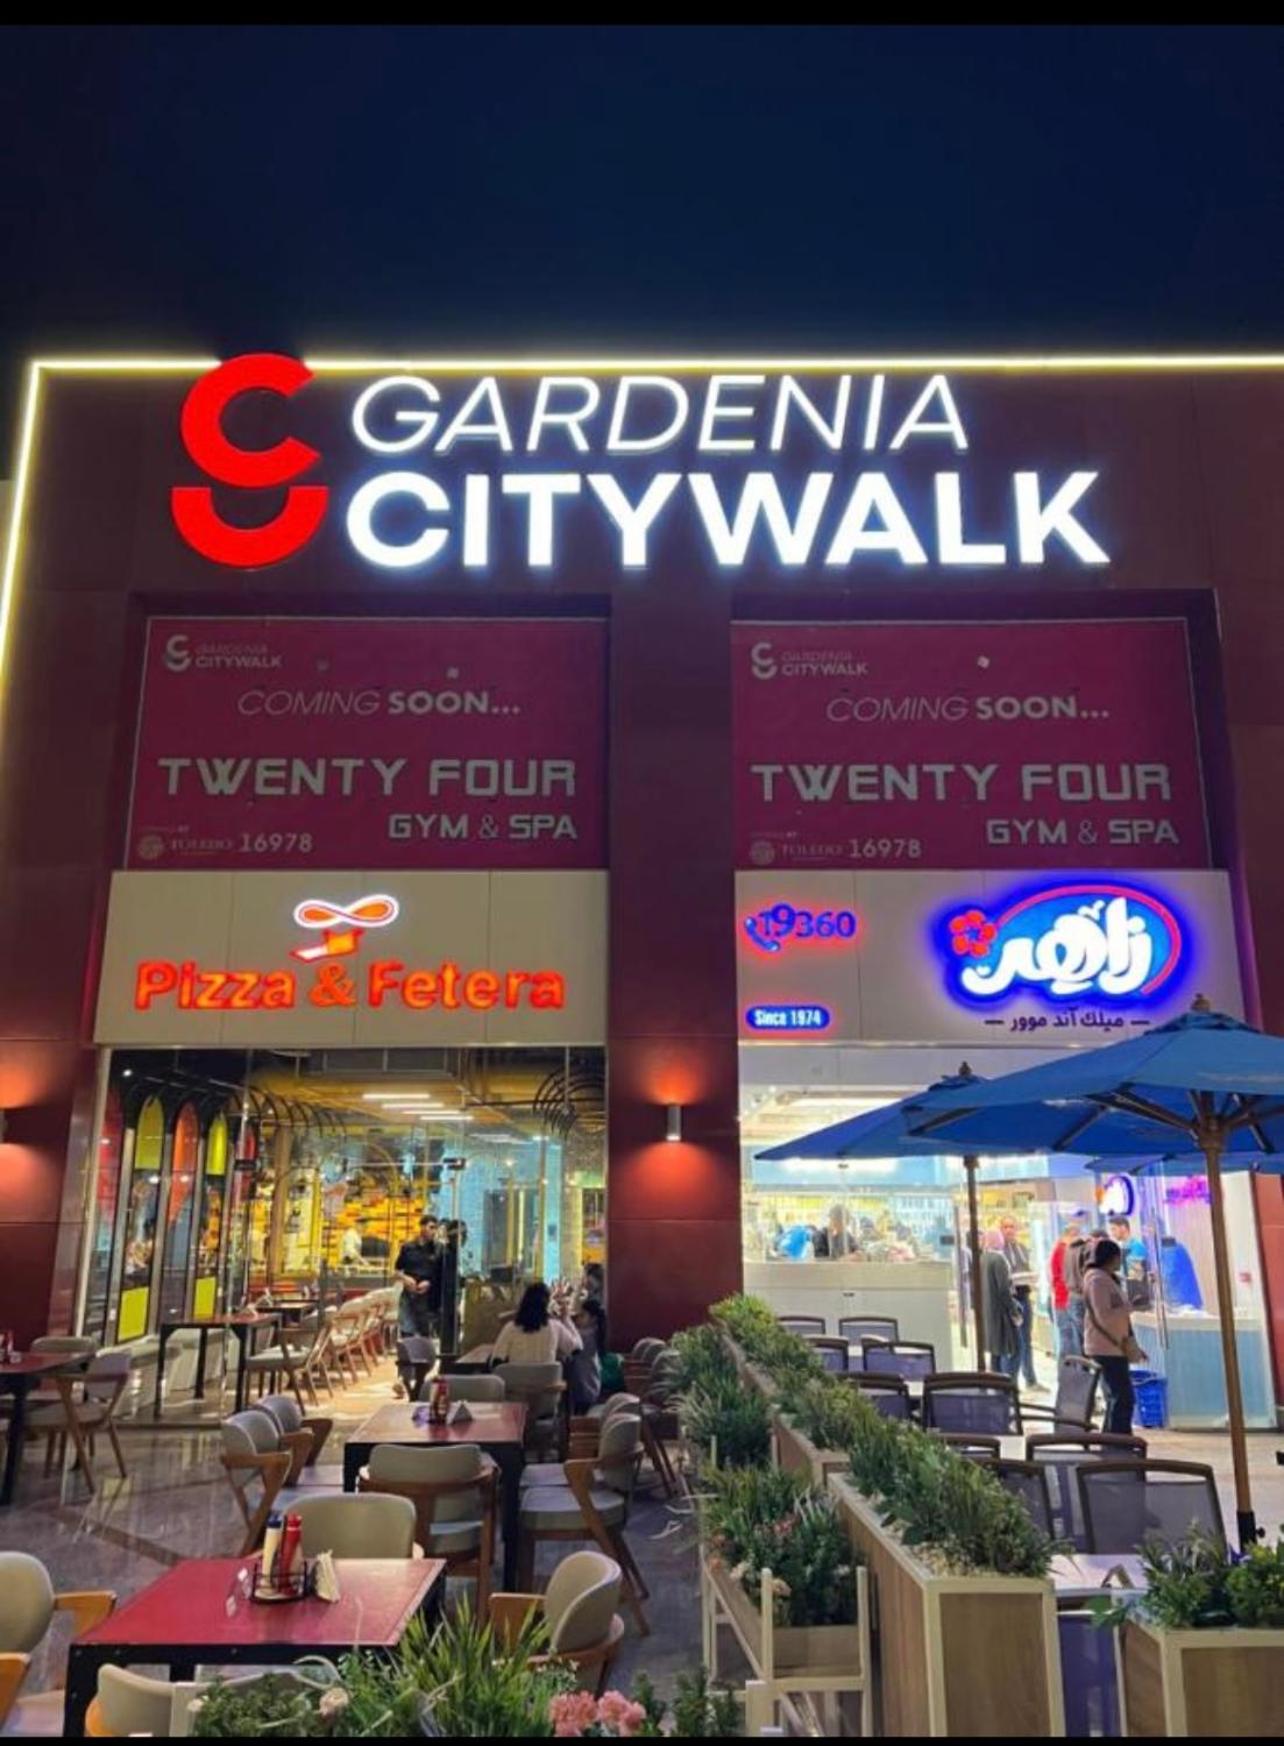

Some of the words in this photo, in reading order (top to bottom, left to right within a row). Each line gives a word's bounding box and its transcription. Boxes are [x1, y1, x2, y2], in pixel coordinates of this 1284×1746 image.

[351, 373, 970, 455] GARDENIA
[346, 471, 1111, 568] CITYWALK
[195, 656, 283, 668] CITYWALK
[781, 664, 869, 676] CITYWALK
[237, 690, 379, 715] COMING
[387, 691, 521, 715] SOON...
[826, 696, 968, 722] COMING
[976, 696, 1110, 719] SOON...
[158, 758, 407, 796] TWENTY
[428, 759, 577, 796] FOUR
[750, 764, 998, 801] TWENTY
[1020, 764, 1172, 800] FOUR
[388, 814, 469, 839] GYM
[479, 815, 499, 839] &
[508, 814, 578, 839] SPA
[986, 820, 1067, 845] GYM
[1077, 821, 1098, 844] &
[1109, 820, 1179, 845] SPA
[240, 833, 313, 852] 16978
[849, 838, 922, 858] 16978
[758, 903, 857, 938] 19360
[135, 960, 295, 1010] Pizza
[310, 962, 354, 1006] &
[368, 960, 565, 1009] Fetera
[755, 1009, 786, 1026] Since
[791, 1009, 821, 1026] 1974
[1010, 1017, 1047, 1032] موور
[1053, 1006, 1077, 1027] آند
[1081, 1010, 1125, 1031] ميلك
